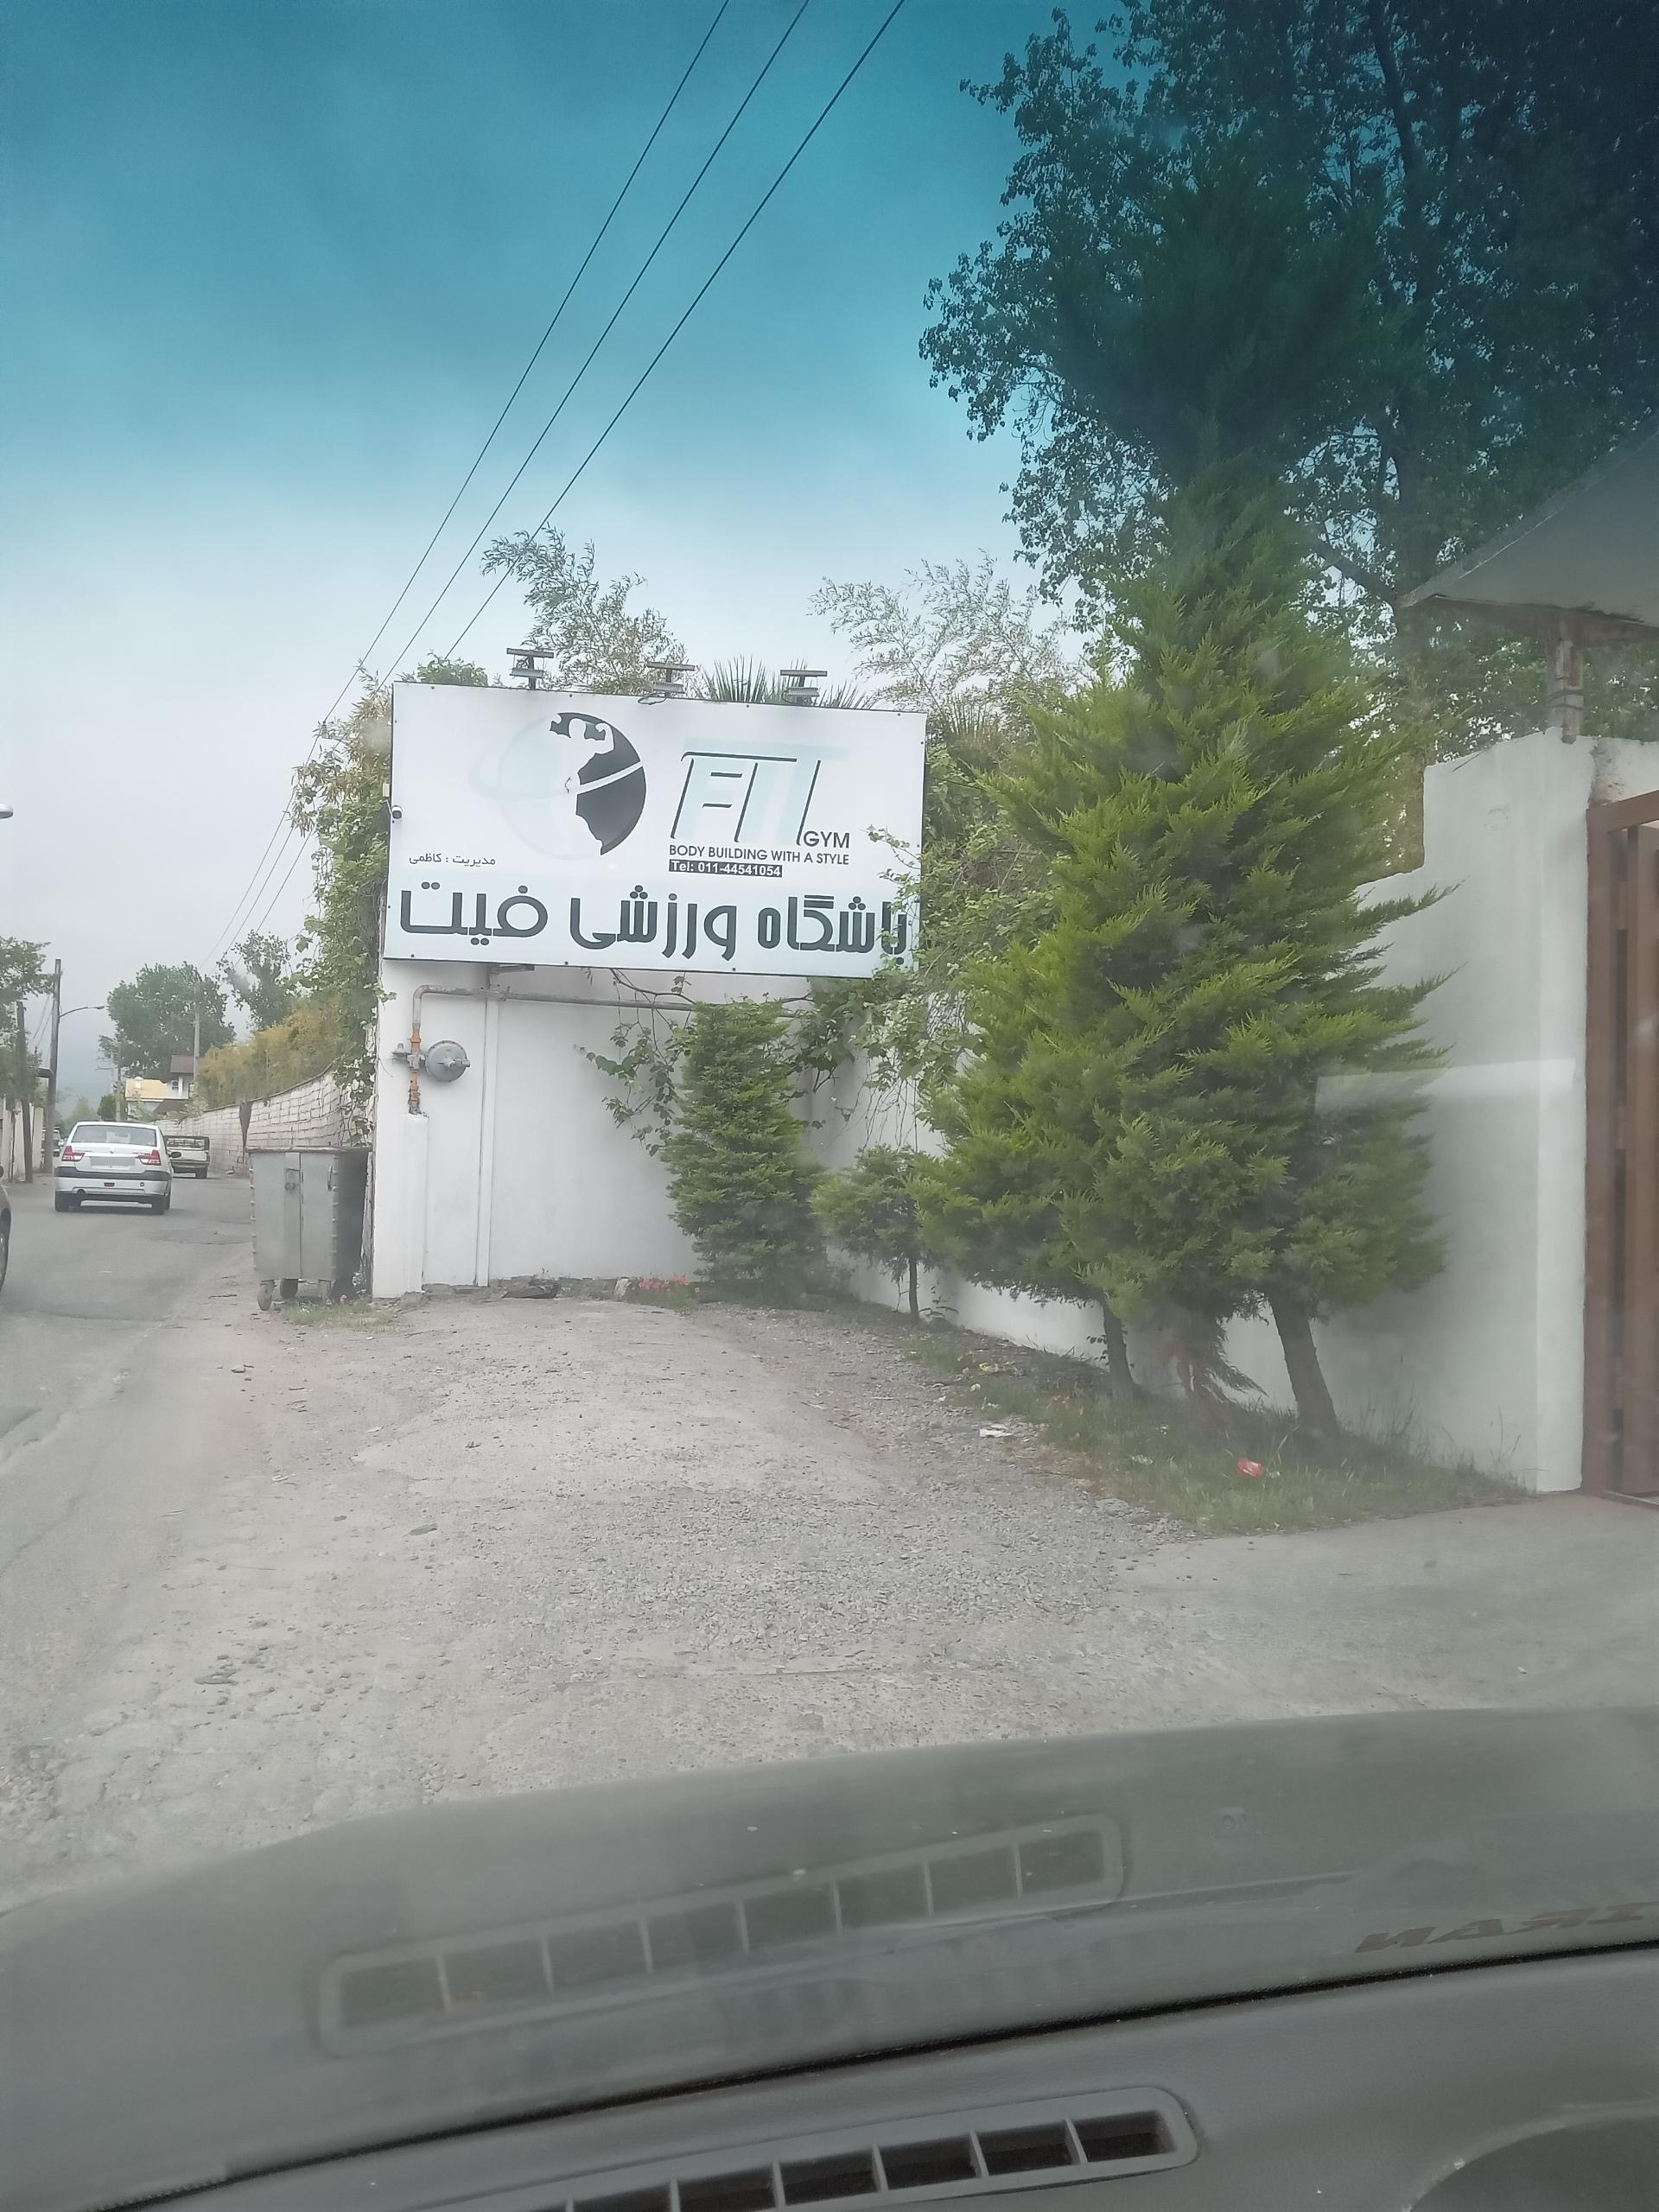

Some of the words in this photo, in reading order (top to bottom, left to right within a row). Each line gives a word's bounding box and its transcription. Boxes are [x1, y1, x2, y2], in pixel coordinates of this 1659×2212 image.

[803, 830, 850, 849] GYM
[409, 853, 442, 865] کاظمی
[452, 855, 496, 867] مدیریت
[670, 844, 705, 857] BODY
[709, 848, 768, 861] BUILDING
[771, 850, 800, 863] WITH
[804, 852, 813, 863] A
[817, 853, 849, 865] STYLE
[671, 860, 694, 873] Tel:
[698, 863, 781, 877] 011-44541054
[400, 881, 548, 946] فیت
[569, 885, 737, 961] ورزشی
[758, 895, 907, 964] باشگاه
